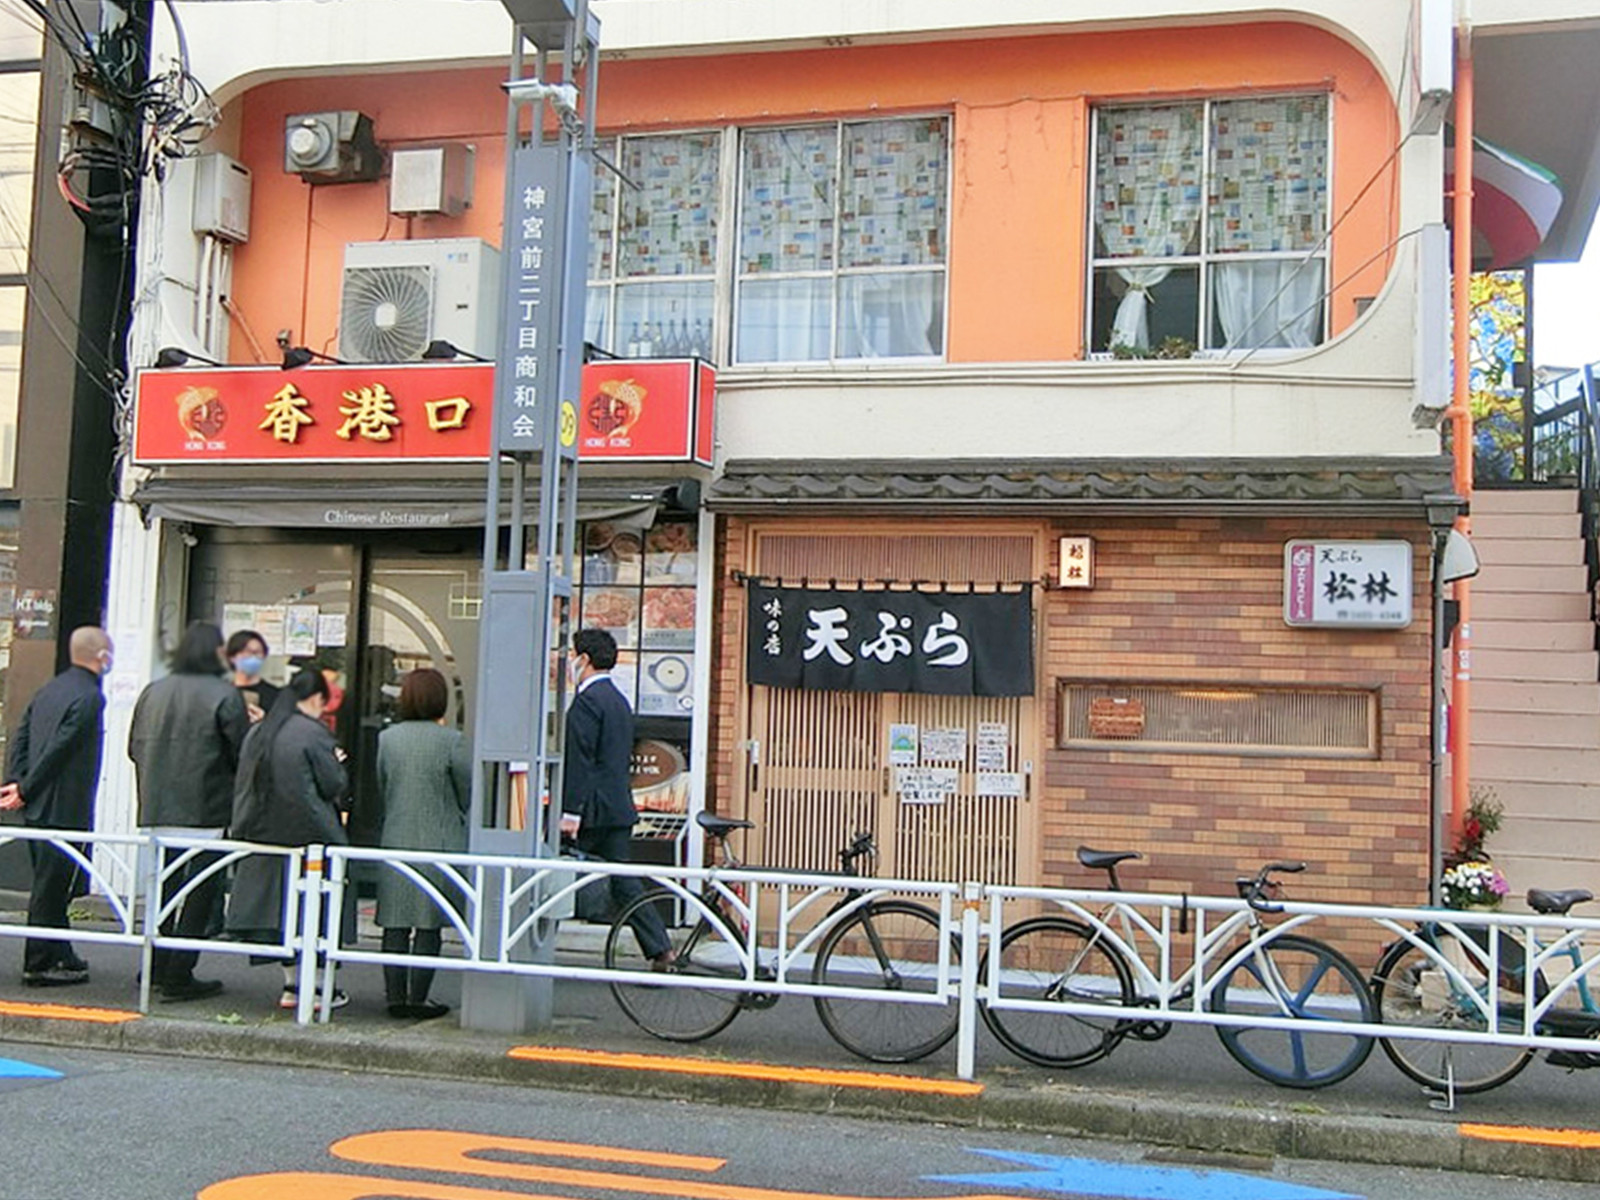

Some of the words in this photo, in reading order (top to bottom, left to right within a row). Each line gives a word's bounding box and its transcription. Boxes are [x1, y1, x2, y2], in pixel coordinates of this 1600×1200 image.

[511, 186, 545, 438] 神宮前二丁目商和会
[259, 382, 471, 443] 香港口
[324, 508, 378, 524] Chinese
[380, 509, 450, 525] Restaurant
[1322, 570, 1398, 605] 松林
[802, 606, 970, 667] 天ぷら
